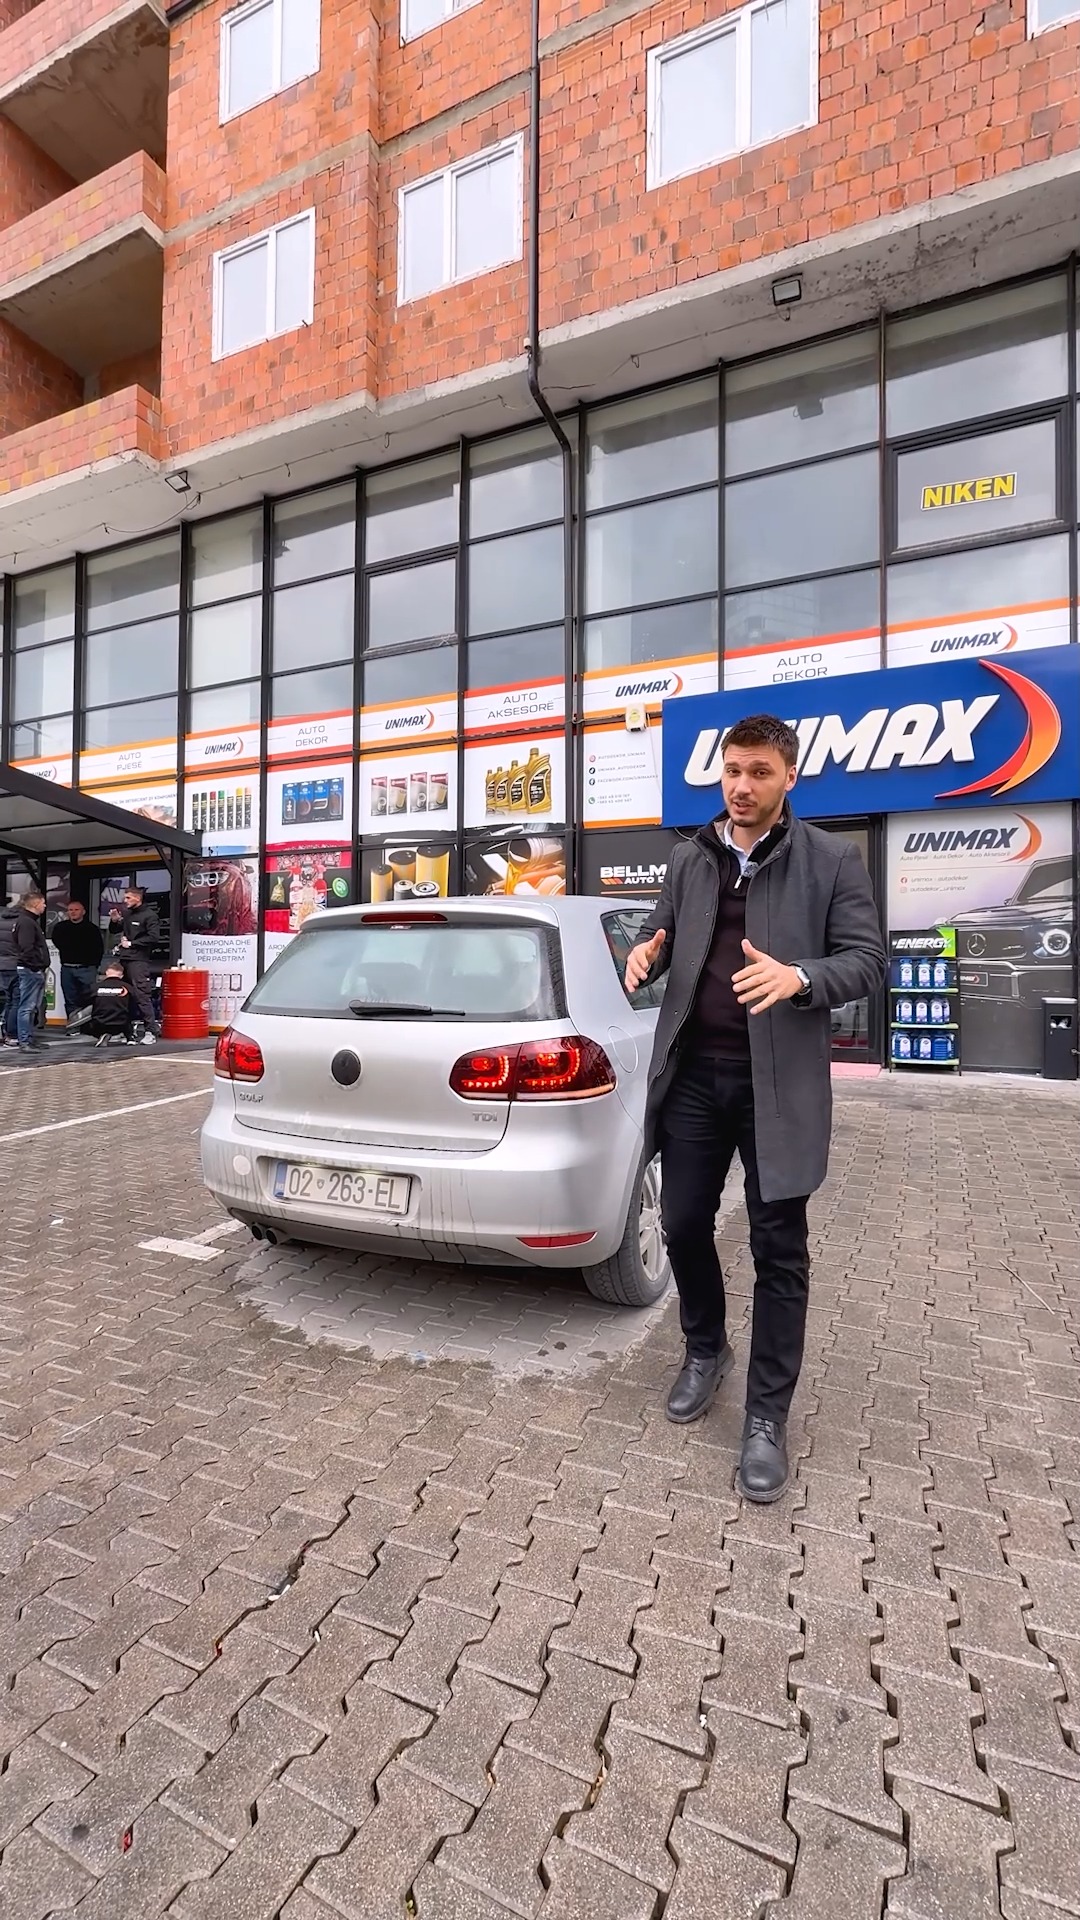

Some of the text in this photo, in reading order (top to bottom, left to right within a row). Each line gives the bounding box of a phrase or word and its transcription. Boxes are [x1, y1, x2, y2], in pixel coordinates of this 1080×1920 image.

[922, 474, 1014, 509] NIKEN
[931, 630, 1003, 653] UNIMAX
[776, 653, 823, 668] AUTO
[772, 666, 828, 683] DEKOR
[615, 679, 672, 697] UNIMAX
[503, 691, 538, 705] AUTO
[487, 701, 554, 720] AKSESORË
[384, 714, 427, 730] UNIMAX
[297, 725, 326, 736] AUTO
[204, 741, 238, 755] UNIMAX
[295, 736, 328, 747] DEKOR
[684, 694, 1000, 787] UIMAX
[118, 751, 142, 762] AUTO
[903, 826, 1019, 853] UNIMAX
[624, 876, 655, 885] AUTO
[191, 939, 234, 947] SHAMPONA
[195, 947, 247, 955] DETERGJENTA
[239, 1091, 264, 1103] GOLF
[288, 1167, 312, 1198] 02
